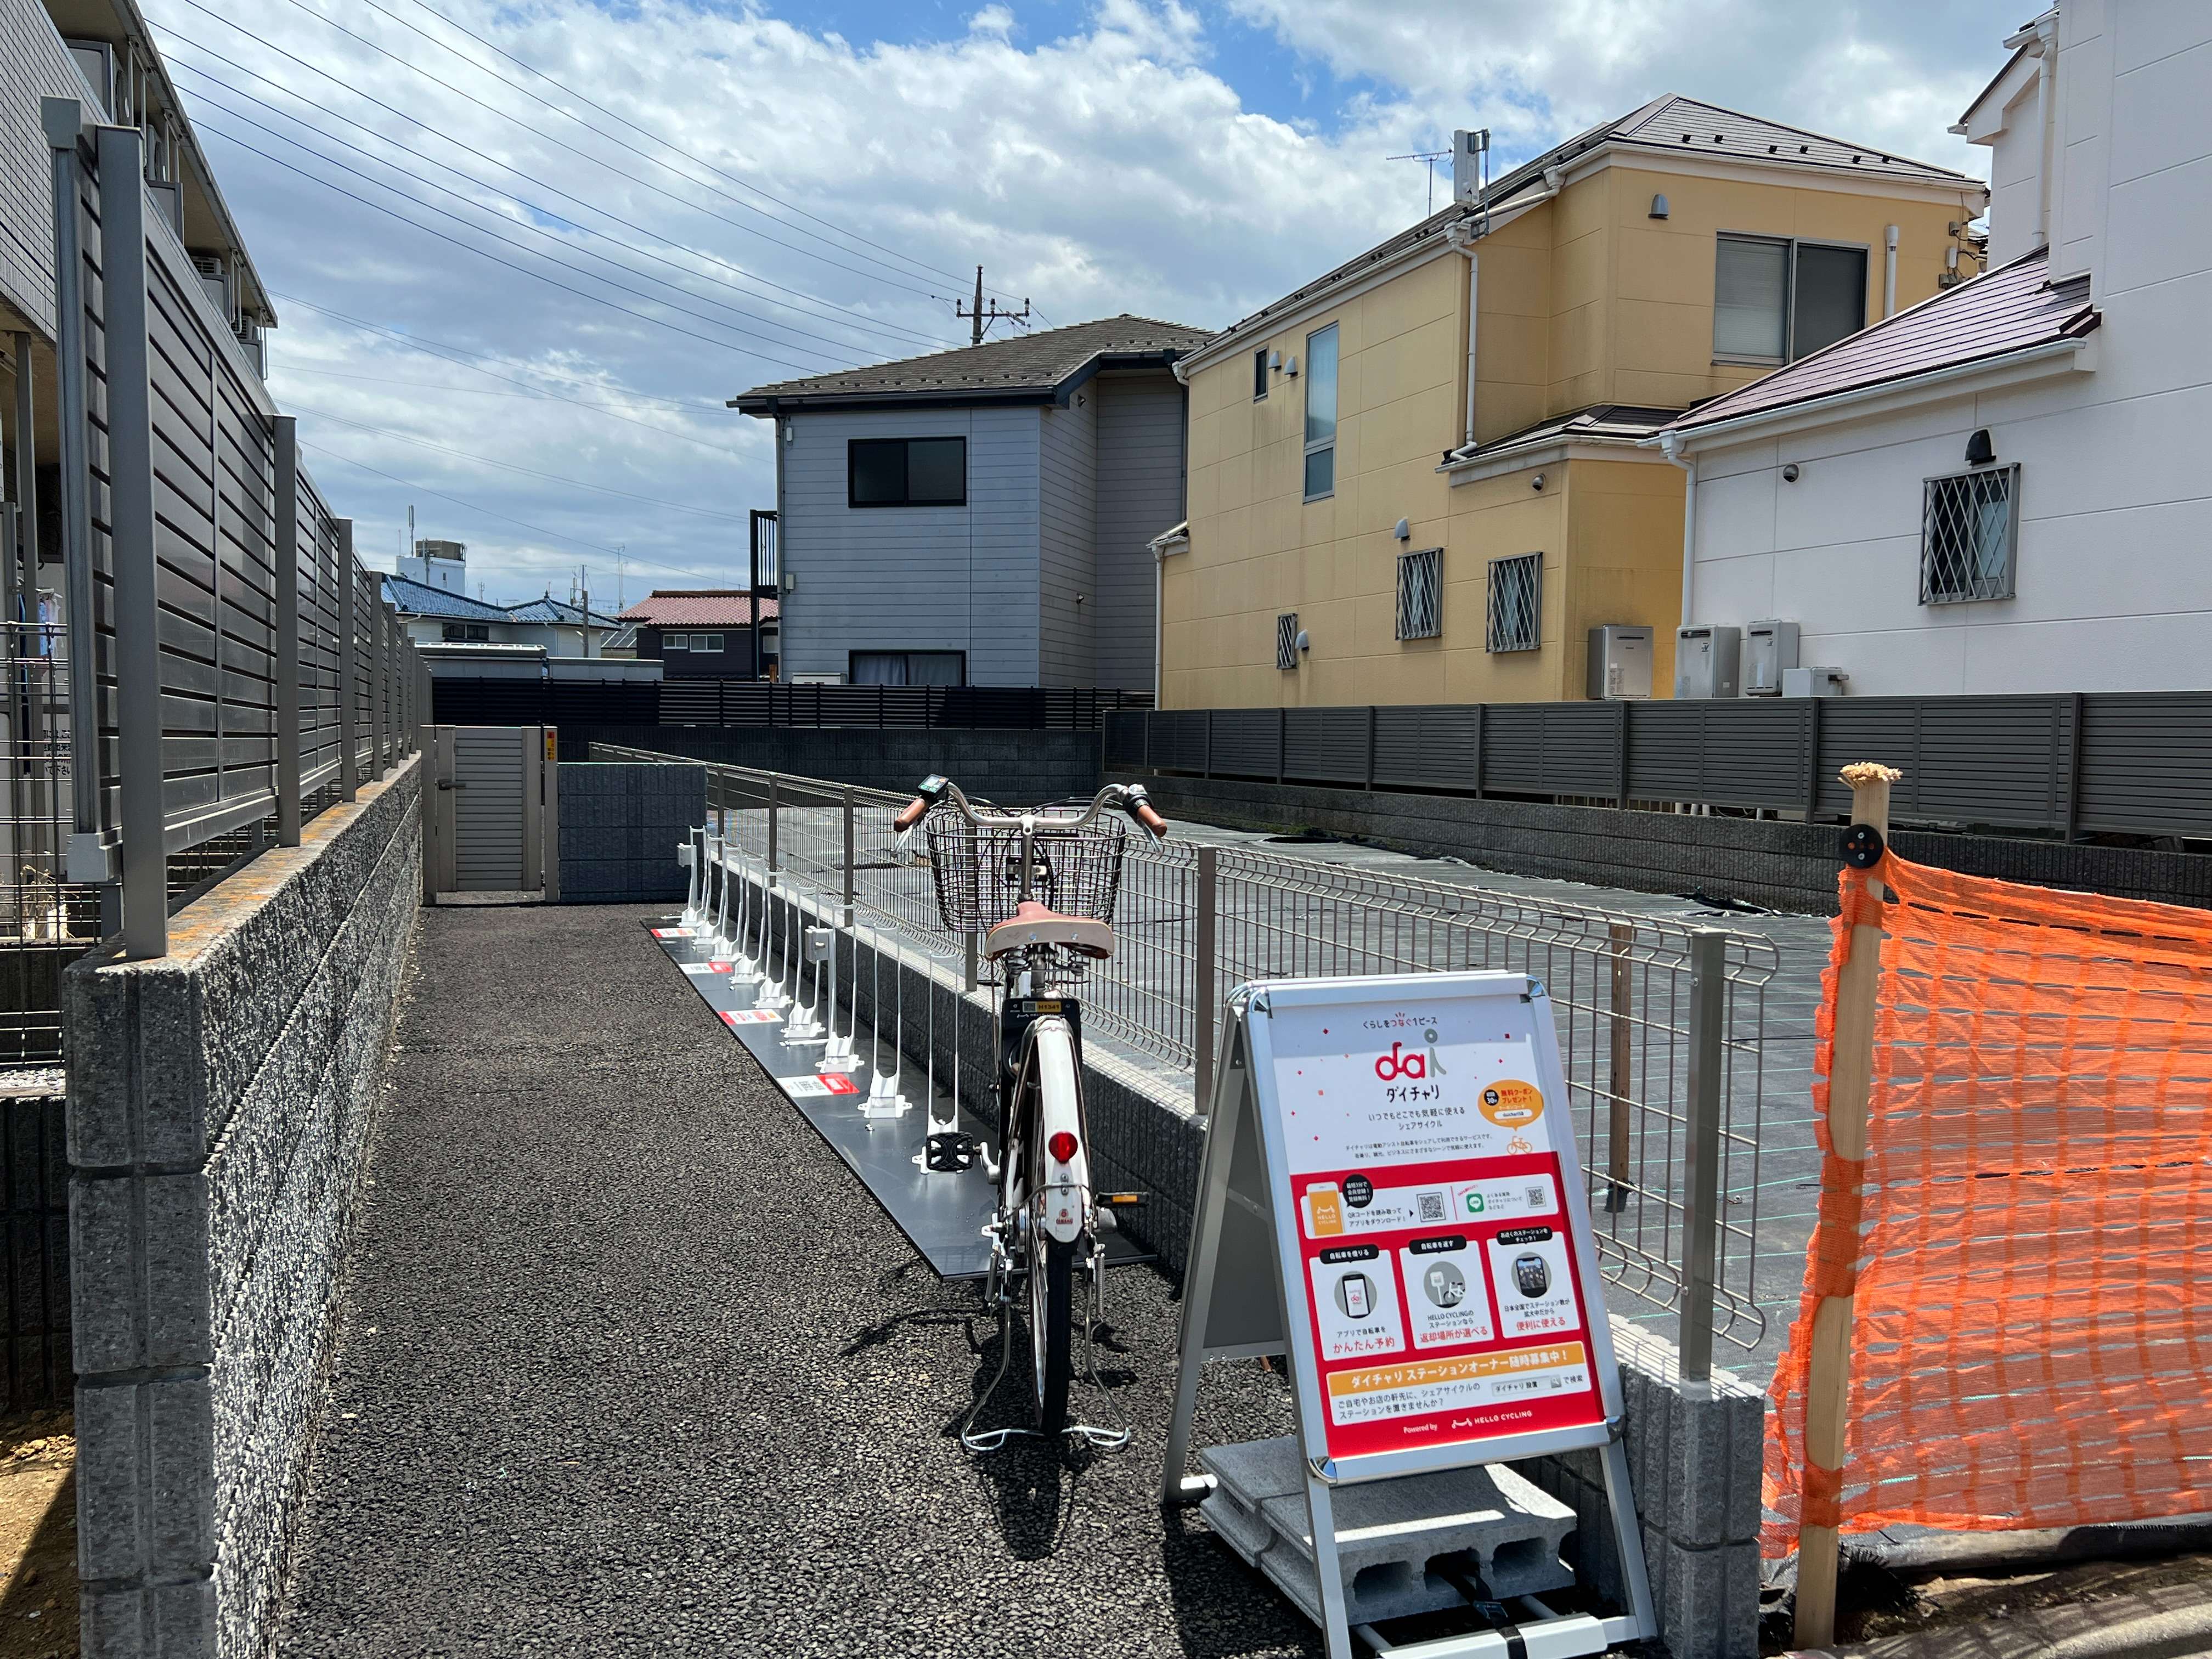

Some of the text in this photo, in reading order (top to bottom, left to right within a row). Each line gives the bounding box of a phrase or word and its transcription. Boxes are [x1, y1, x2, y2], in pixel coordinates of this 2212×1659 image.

[1363, 1017, 1438, 1029] くらしをつなぐ1ピース
[1386, 1084, 1440, 1103] ダイチャリ
[1501, 1088, 1532, 1097] 無料クーポン
[1368, 1107, 1465, 1121] いつでもどこでも気軽に使える
[1398, 1120, 1443, 1131] シェアサイクル
[1347, 1207, 1402, 1218] QRコードを読み取って
[1499, 1228, 1549, 1239] お近くのステーションを
[1420, 1240, 1454, 1250] 自転車を返す
[1329, 1250, 1370, 1260] 自転車を借りる
[1504, 1298, 1571, 1312] 日本全国でステーション数が
[1427, 1312, 1445, 1321] HELLO
[1523, 1307, 1555, 1318] 拡大中だから
[1429, 1318, 1474, 1329] ステーションなら
[1516, 1317, 1566, 1331] 便利に使える
[1336, 1326, 1386, 1338] アプリで自転車を
[1420, 1326, 1488, 1344] 返却場所が選べる
[1333, 1336, 1395, 1355] かんたん予約
[1351, 1371, 1404, 1389] ダイチャリ
[1562, 1374, 1584, 1385] で検索
[1495, 1380, 1538, 1393] ダイチャリ 設置
[1338, 1381, 1481, 1409] ご自宅やお店の軒先に、シェアサイクルの
[1339, 1397, 1446, 1420] ステーションを置きませんか？
[1474, 1409, 1533, 1425] HELLO CYCLING
[1403, 1423, 1438, 1435] Powered by
